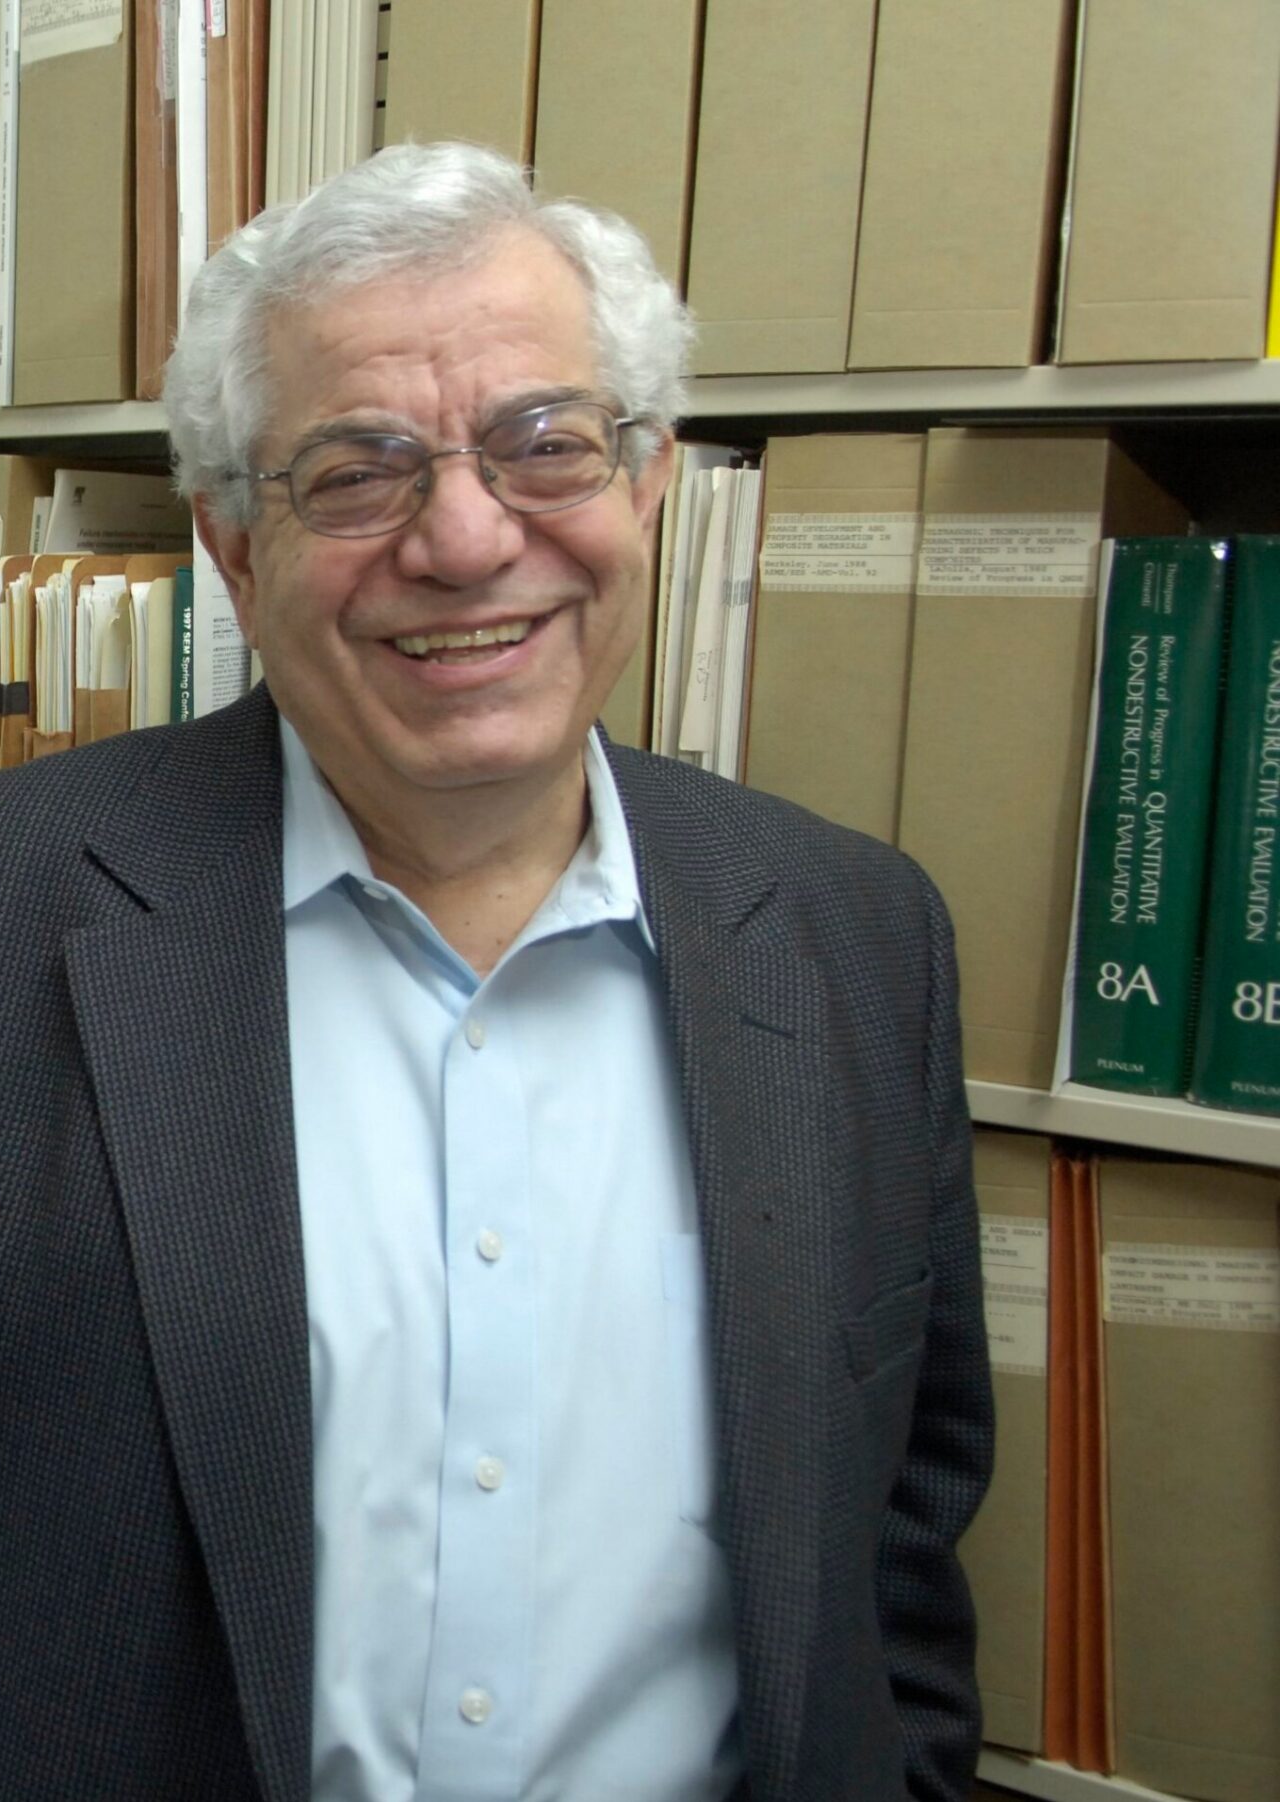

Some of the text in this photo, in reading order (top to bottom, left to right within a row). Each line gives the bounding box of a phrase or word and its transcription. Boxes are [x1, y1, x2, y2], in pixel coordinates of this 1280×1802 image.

[183, 607, 192, 629] 1997
[182, 631, 192, 655] SEM
[180, 656, 191, 689] Spring
[1110, 635, 1149, 924] NONDESTRUCTIVE EVALUATION
[1136, 635, 1176, 924] Review of Progress in QUANTITATIVE
[1246, 827, 1276, 943] EVALUATION
[1096, 962, 1160, 1006] 8A
[1097, 1058, 1145, 1074] PLENUM
